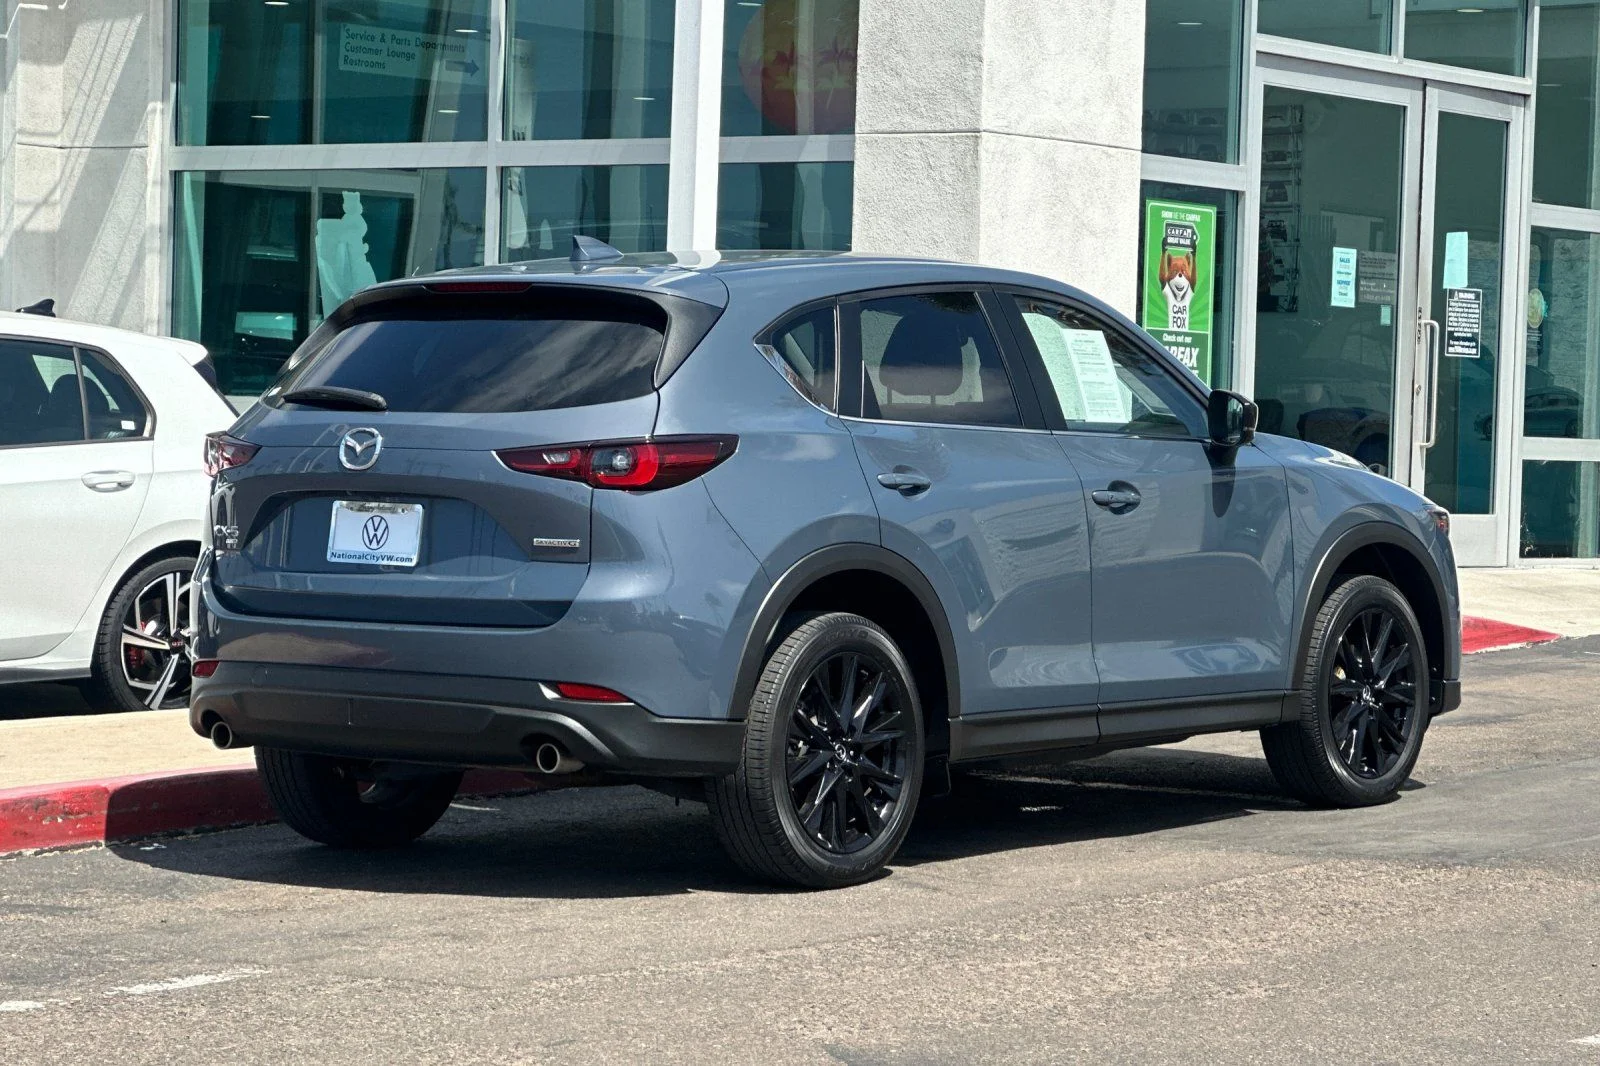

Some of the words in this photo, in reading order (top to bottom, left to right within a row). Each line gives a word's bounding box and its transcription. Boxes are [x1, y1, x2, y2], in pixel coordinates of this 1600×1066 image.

[345, 28, 376, 42] Service
[380, 33, 387, 43] &
[390, 35, 411, 47] Parts
[344, 41, 383, 56] Customer
[387, 47, 416, 62] Lounge
[343, 54, 386, 70] Restrooms
[1172, 304, 1187, 315] CAR
[1172, 316, 1186, 329] FOX
[1162, 333, 1176, 342] Check
[329, 551, 414, 563] NationalCityVW.com
